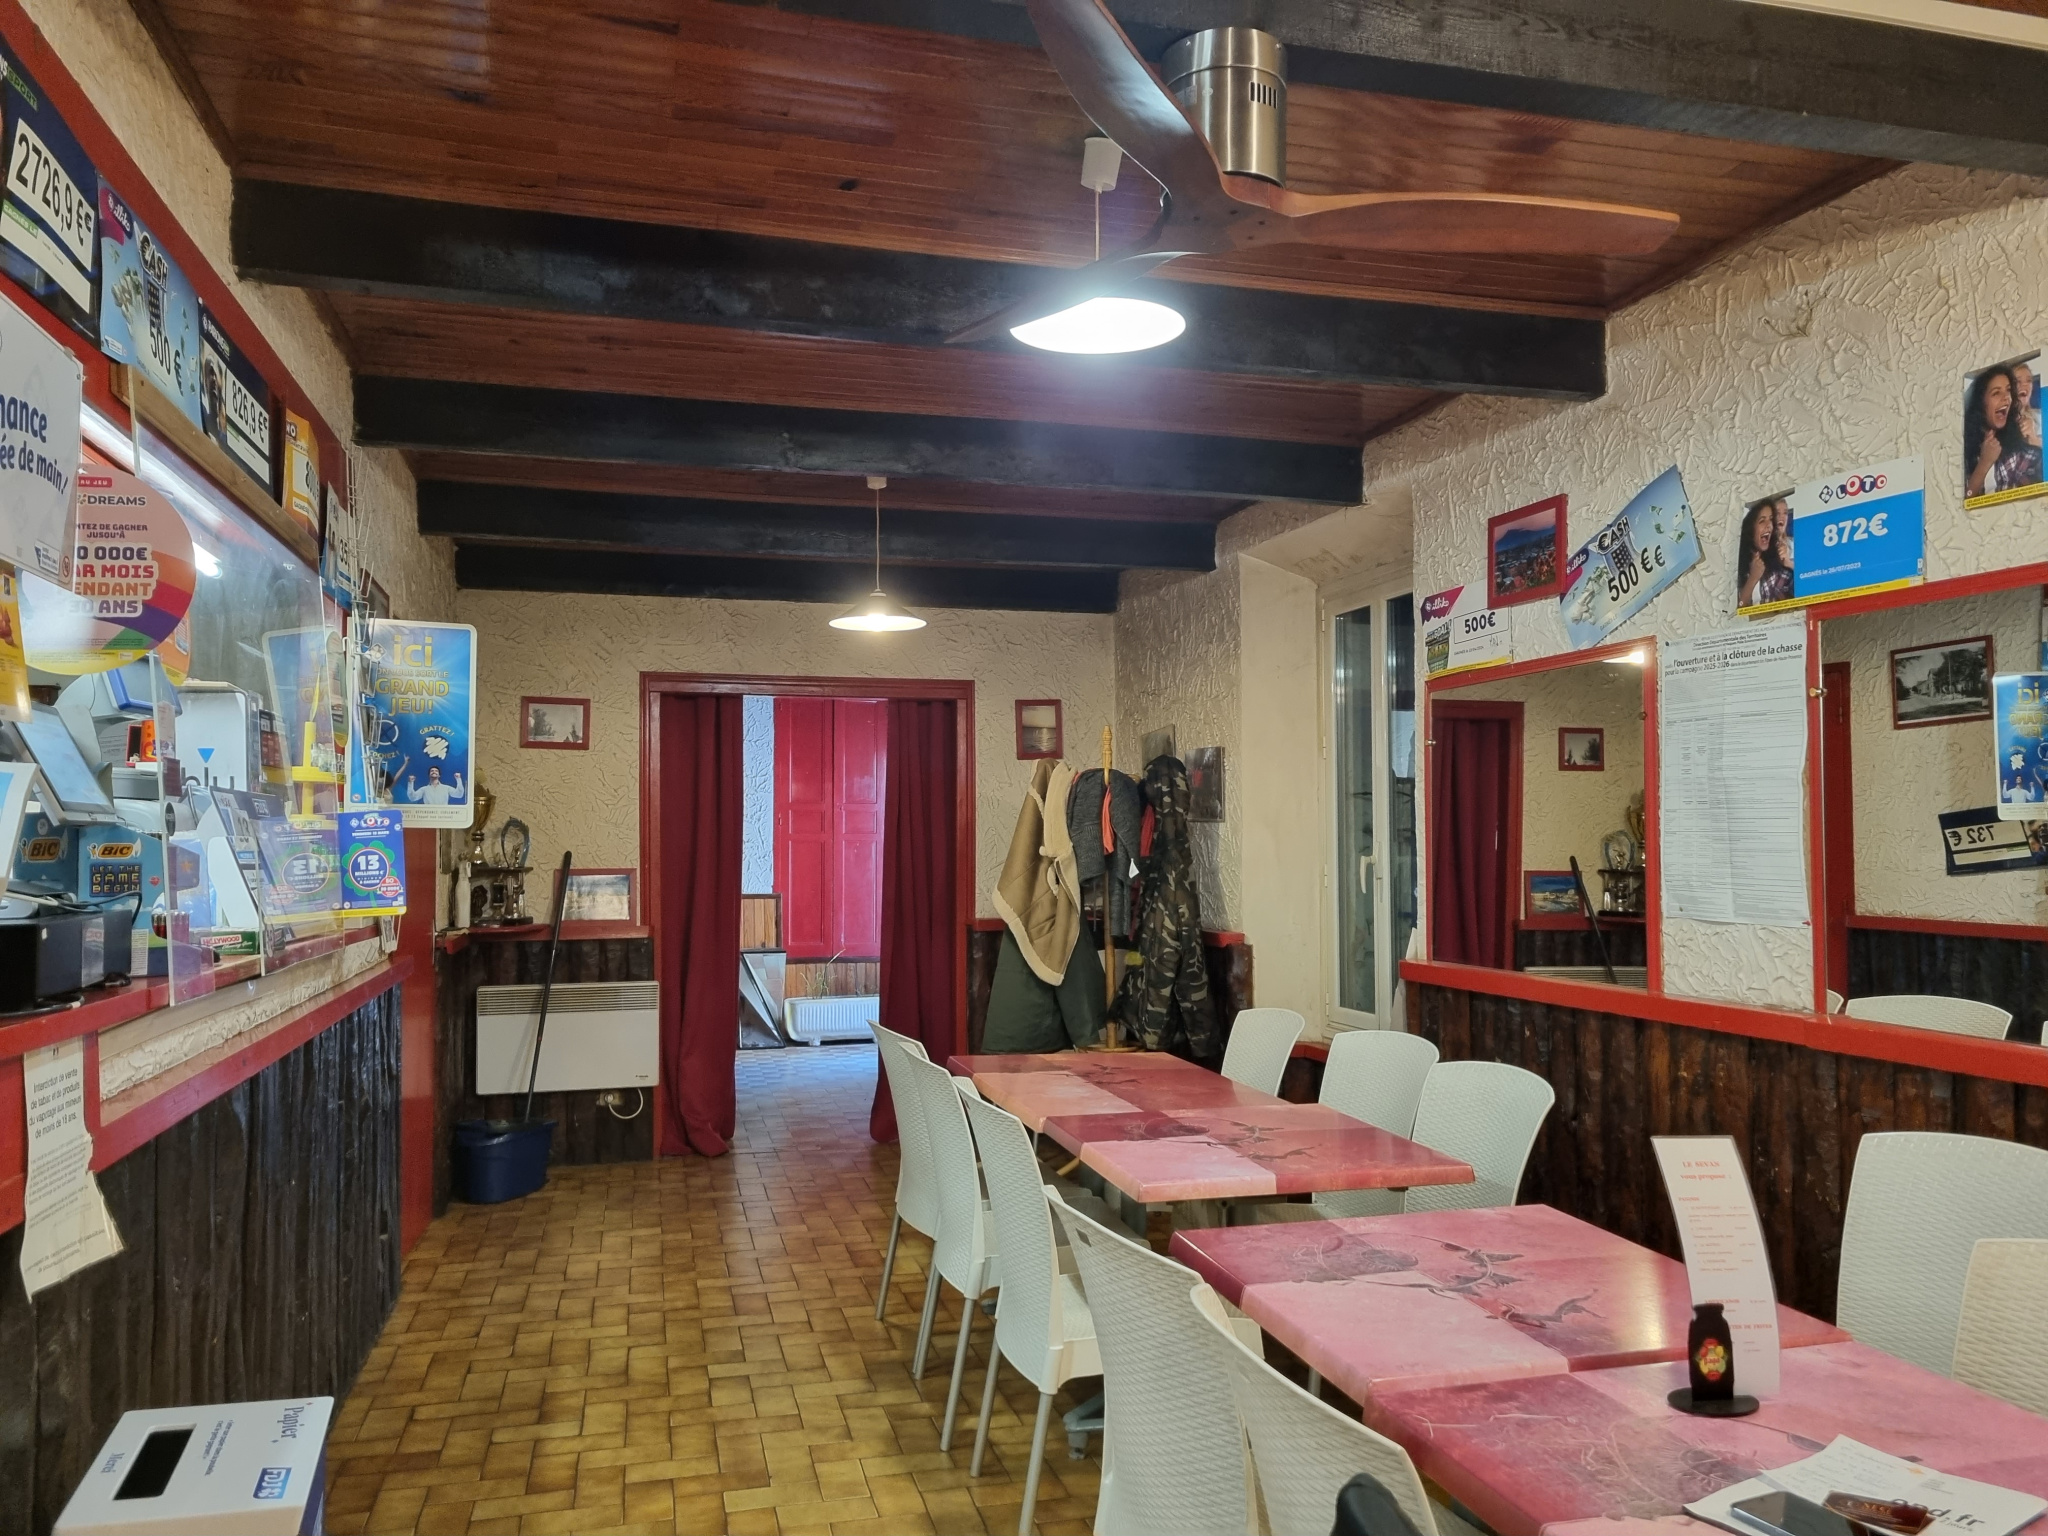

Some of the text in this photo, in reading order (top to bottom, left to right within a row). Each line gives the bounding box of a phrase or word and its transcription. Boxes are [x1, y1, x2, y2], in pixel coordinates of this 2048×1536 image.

[16, 133, 73, 233] 2726,9
[150, 316, 171, 376] 500
[232, 379, 256, 434] 826,9
[18, 440, 34, 474] de
[1836, 475, 1888, 499] LOTO
[87, 495, 146, 506] DREAMS
[99, 523, 111, 531] DE
[113, 523, 148, 531] GAGNER
[1823, 513, 1889, 547] 872€
[94, 546, 148, 560] 000€
[101, 564, 154, 579] MOIS
[1608, 544, 1665, 602] 500 € €
[98, 599, 138, 614] ANS
[1432, 597, 1449, 611] illiko
[1464, 611, 1496, 634] 500€
[393, 634, 433, 667] ici
[1673, 656, 1708, 668] l'ouverture
[1709, 654, 1716, 663] et
[1722, 651, 1728, 661] la
[1729, 649, 1756, 660] clôture
[1757, 646, 1767, 656] de
[1768, 645, 1775, 655] la
[1776, 643, 1803, 654] chasse
[375, 677, 450, 697] GRAND
[419, 725, 451, 735] GRATTEZ
[360, 817, 390, 828] LOTO
[357, 855, 380, 871] 13
[93, 874, 139, 884] GAME
[93, 884, 139, 893] BEGIN
[203, 935, 240, 946] HOLLYWOOD
[33, 1068, 78, 1093] Interdiction de vente
[30, 1101, 37, 1110] de
[38, 1095, 51, 1107] tabac
[51, 1092, 56, 1101] et
[62, 1081, 80, 1097] produits
[28, 1116, 35, 1126] du
[36, 1107, 56, 1123] vapotage
[34, 1128, 41, 1139] de
[42, 1122, 55, 1135] moins
[56, 1119, 61, 1127] de
[277, 1406, 305, 1439] Papier
[101, 1452, 125, 1474] Merci
